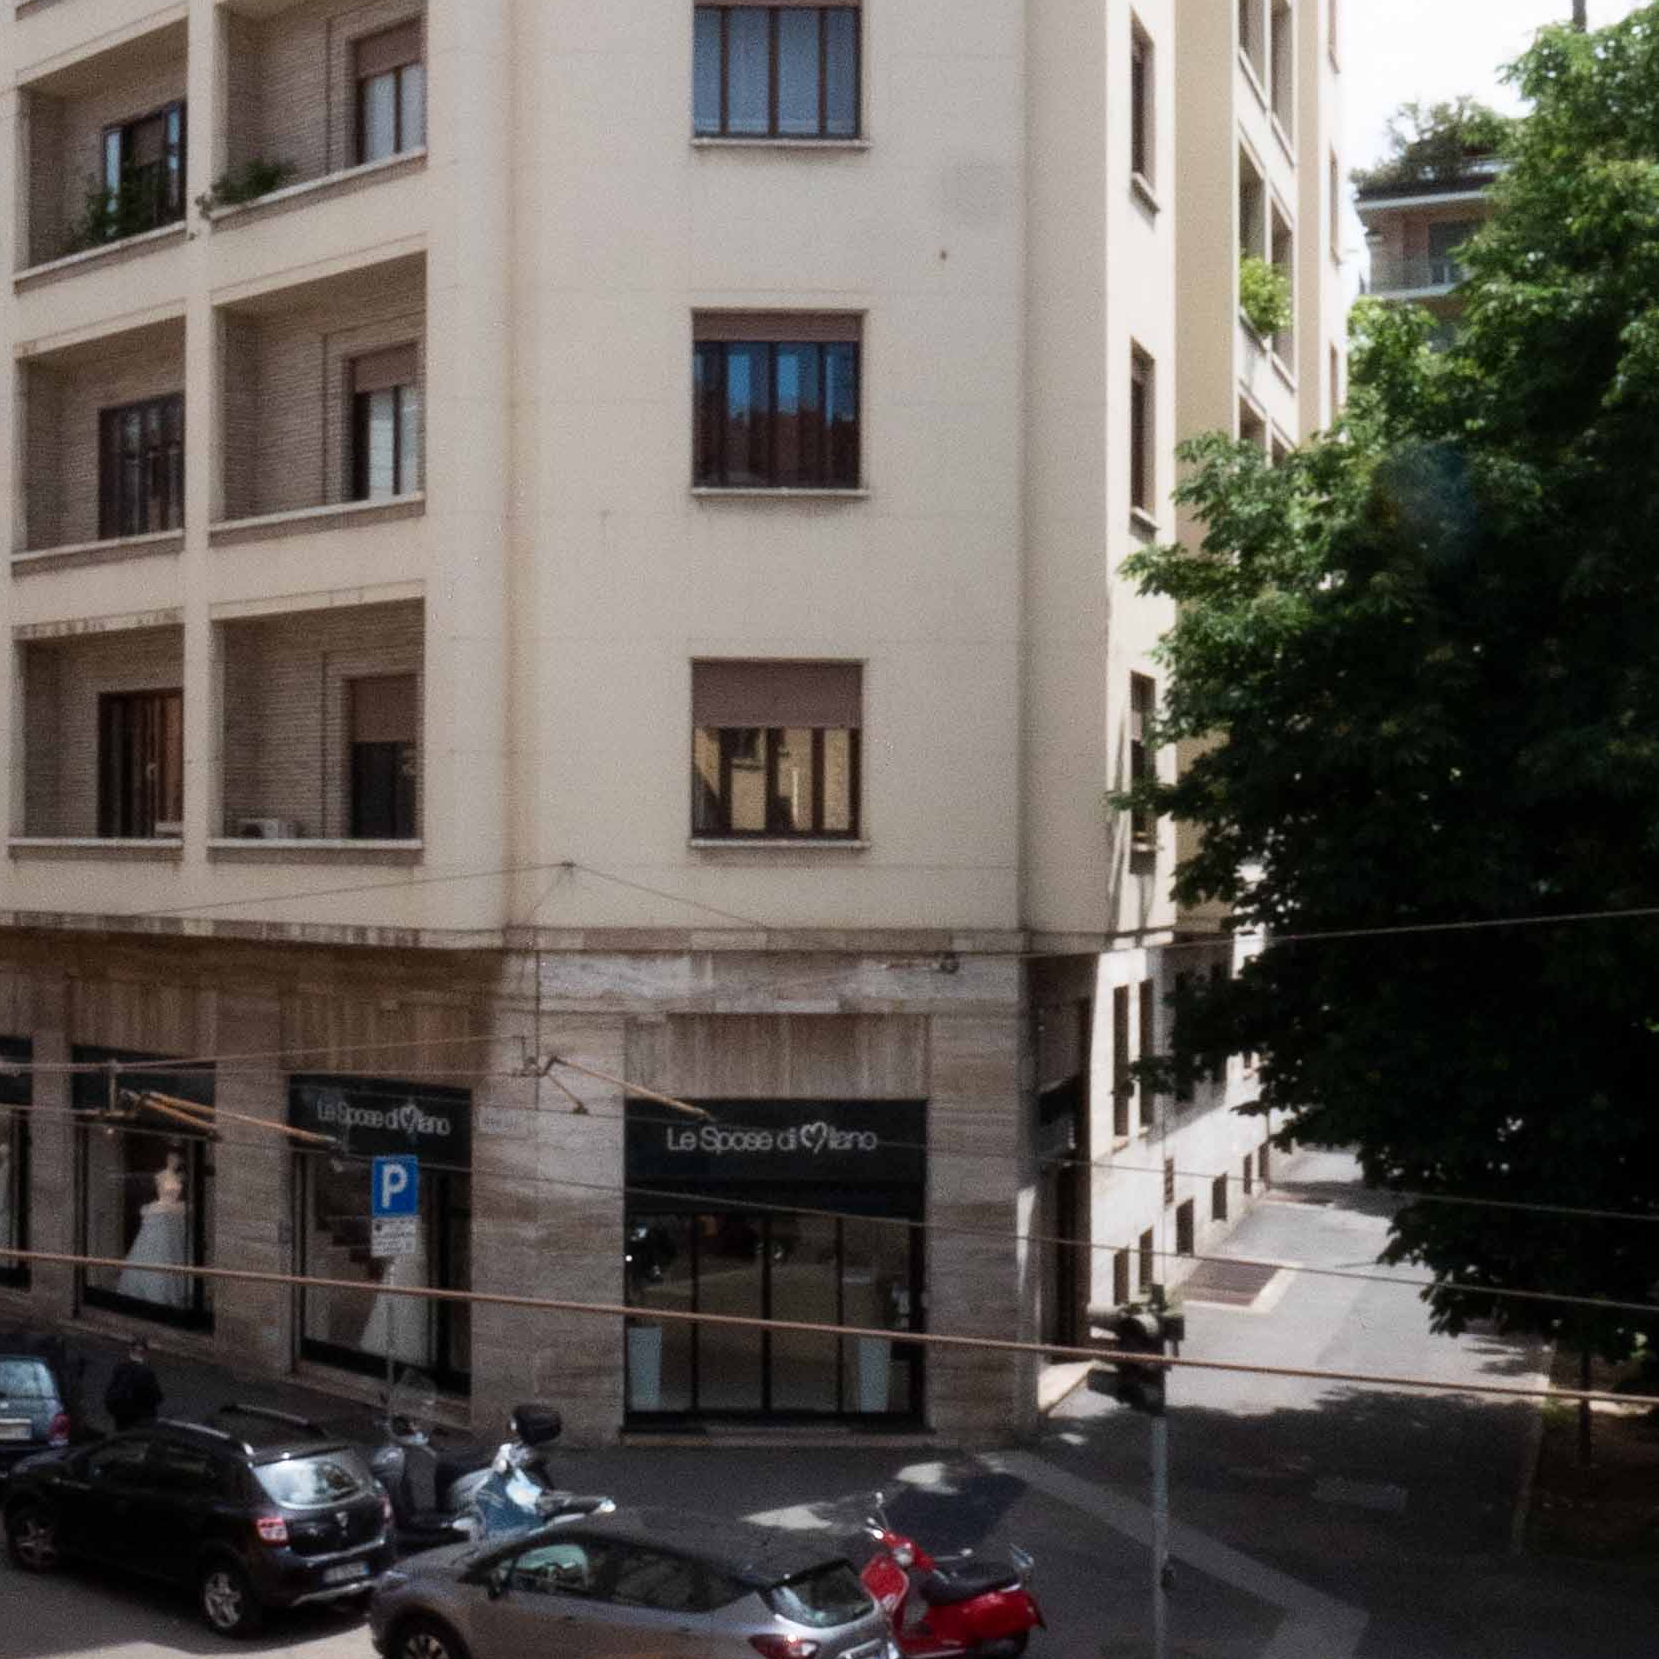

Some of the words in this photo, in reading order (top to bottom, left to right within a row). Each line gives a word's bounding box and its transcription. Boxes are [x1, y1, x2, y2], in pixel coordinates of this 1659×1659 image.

[666, 1125, 698, 1152] Le
[699, 1125, 773, 1155] Spose
[776, 1126, 798, 1152] di
[381, 1163, 408, 1208] P
